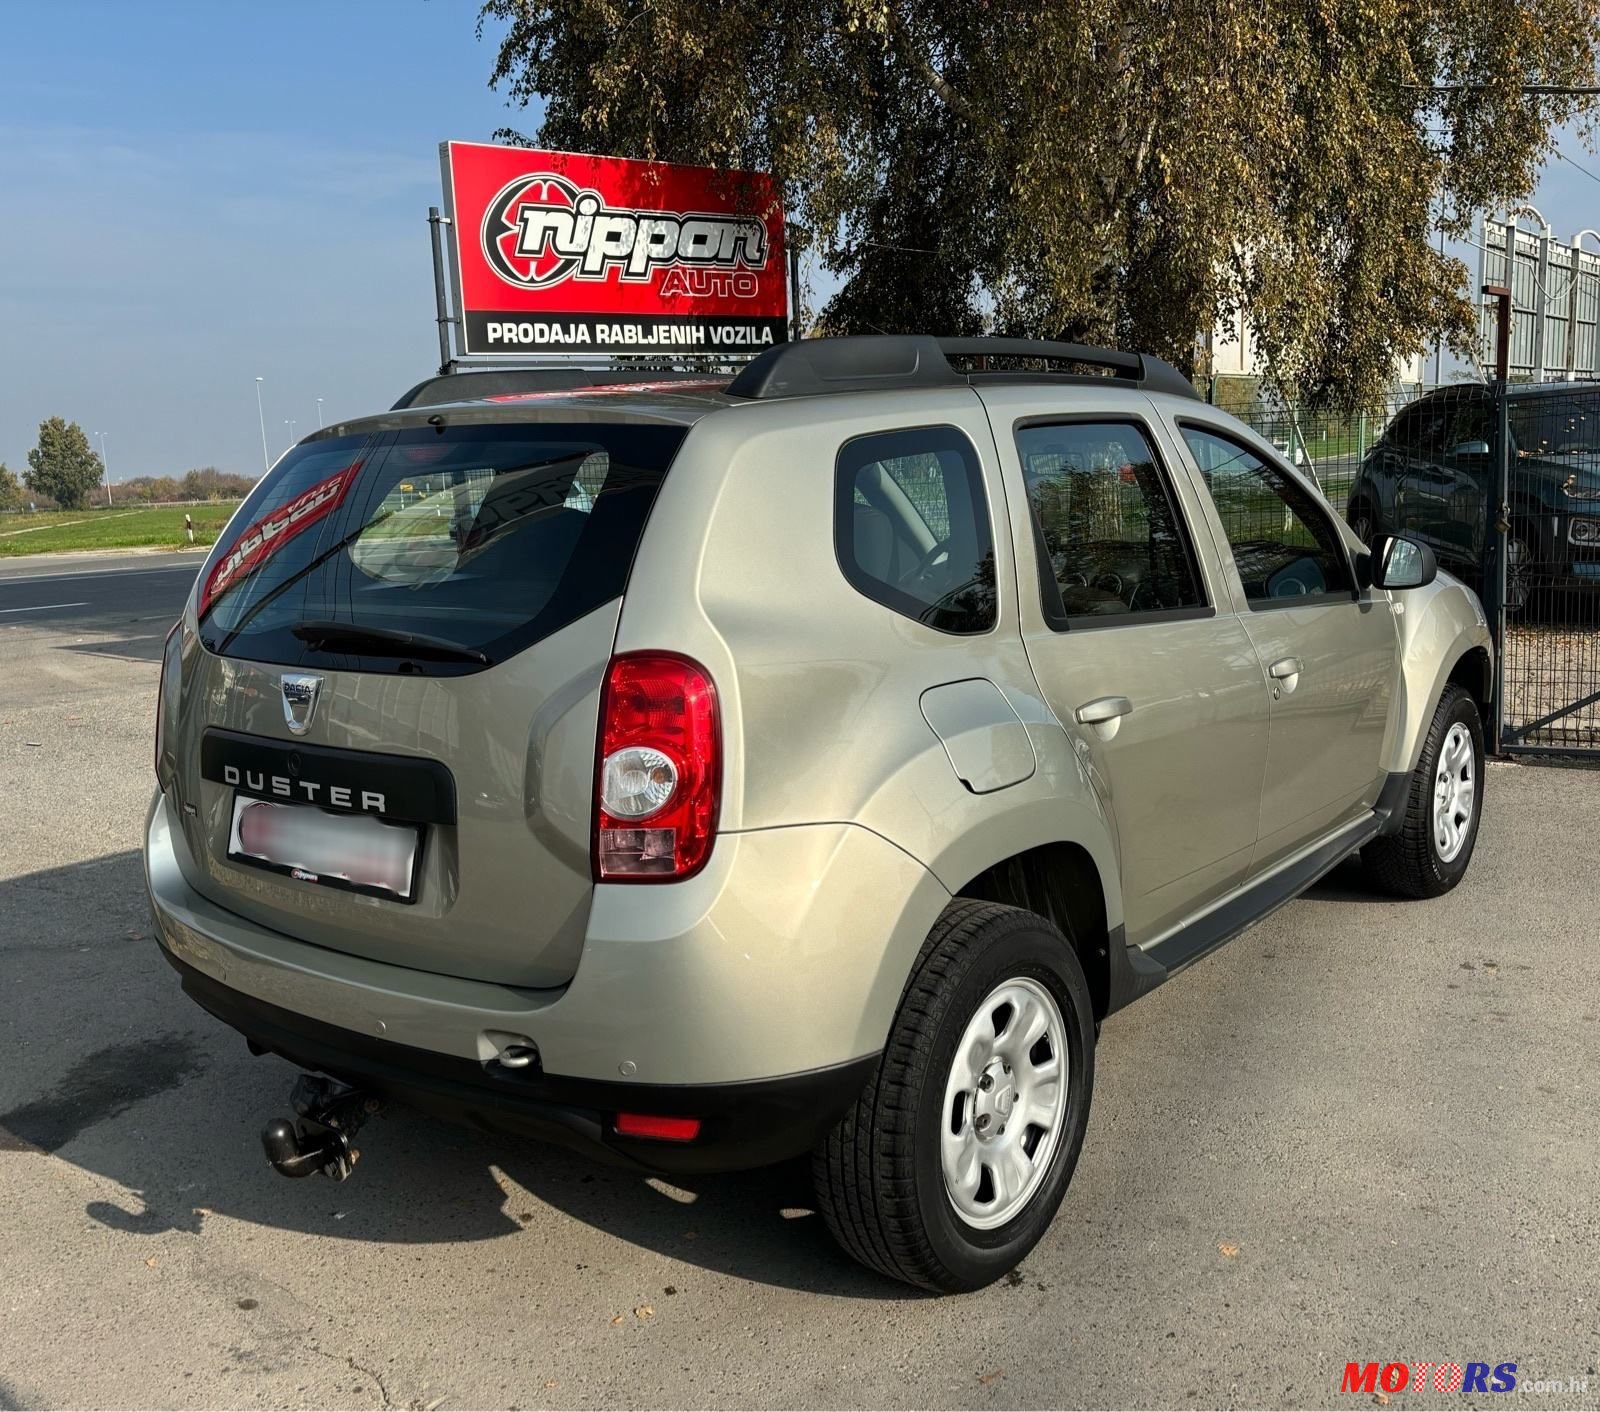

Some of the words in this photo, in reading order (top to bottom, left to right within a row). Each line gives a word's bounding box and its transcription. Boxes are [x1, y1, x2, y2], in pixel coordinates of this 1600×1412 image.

[517, 193, 766, 278] nippon
[660, 268, 759, 298] AUTO
[487, 322, 590, 344] PRODAJA
[596, 324, 705, 345] RABLJENIH
[709, 325, 773, 345] VOZILA
[224, 765, 386, 813] DUSTER
